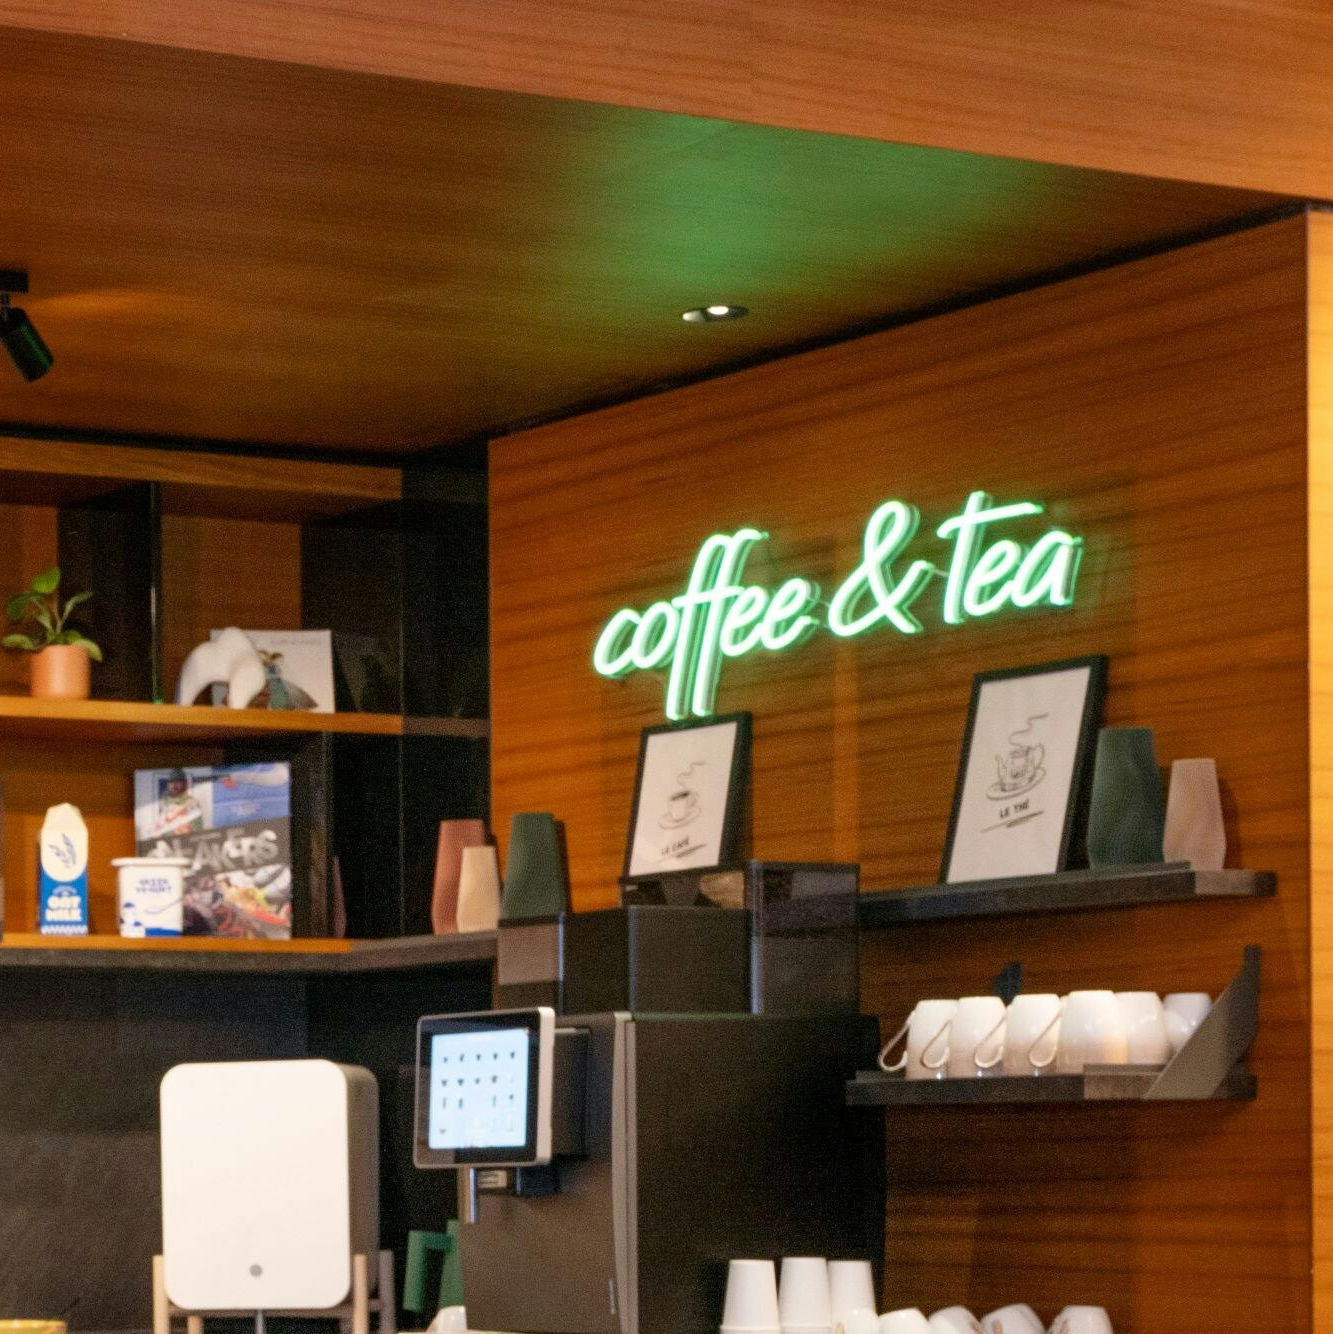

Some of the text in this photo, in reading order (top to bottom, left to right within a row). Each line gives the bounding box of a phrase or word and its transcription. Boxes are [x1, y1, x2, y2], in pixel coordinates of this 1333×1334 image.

[592, 490, 1083, 721] coffee & tea
[999, 806, 1010, 819] LE
